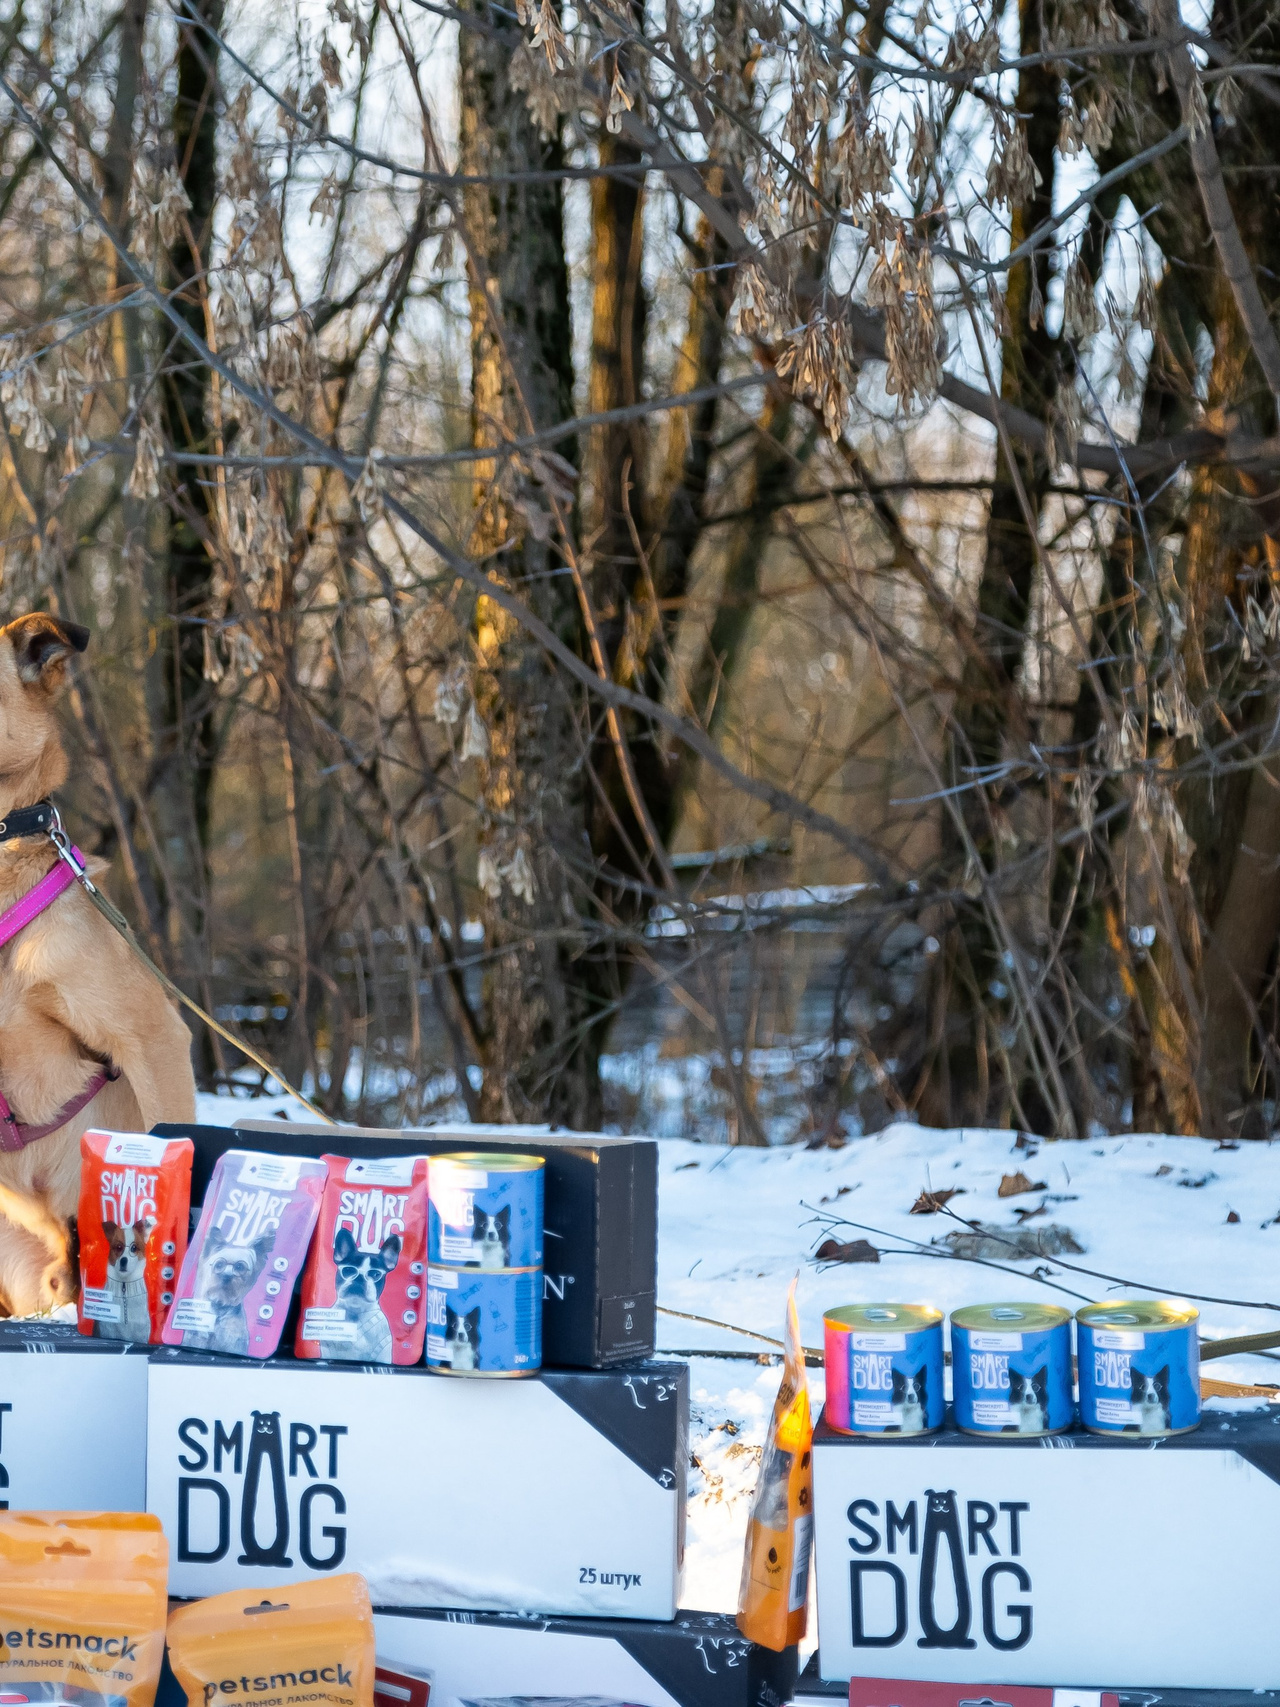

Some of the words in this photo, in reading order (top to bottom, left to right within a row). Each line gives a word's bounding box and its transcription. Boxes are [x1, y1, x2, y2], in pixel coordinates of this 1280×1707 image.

[101, 1169, 159, 1198] SMART
[226, 1189, 292, 1217] SMART
[339, 1189, 409, 1218] SMART
[853, 1354, 893, 1369] SMART
[971, 1353, 1009, 1369] SMART
[1095, 1351, 1132, 1367] SMART
[177, 1411, 348, 1478] SMART
[177, 1478, 348, 1571] DOG
[846, 1489, 1031, 1557] SMART
[579, 1567, 597, 1584] 25
[600, 1571, 643, 1589] штук
[850, 1559, 1033, 1652] DOG
[67, 1660, 134, 1682] ЛАКОМСТВО
[203, 1664, 353, 1707] petsmack
[286, 1692, 354, 1706] ЛАКОМСТВО
